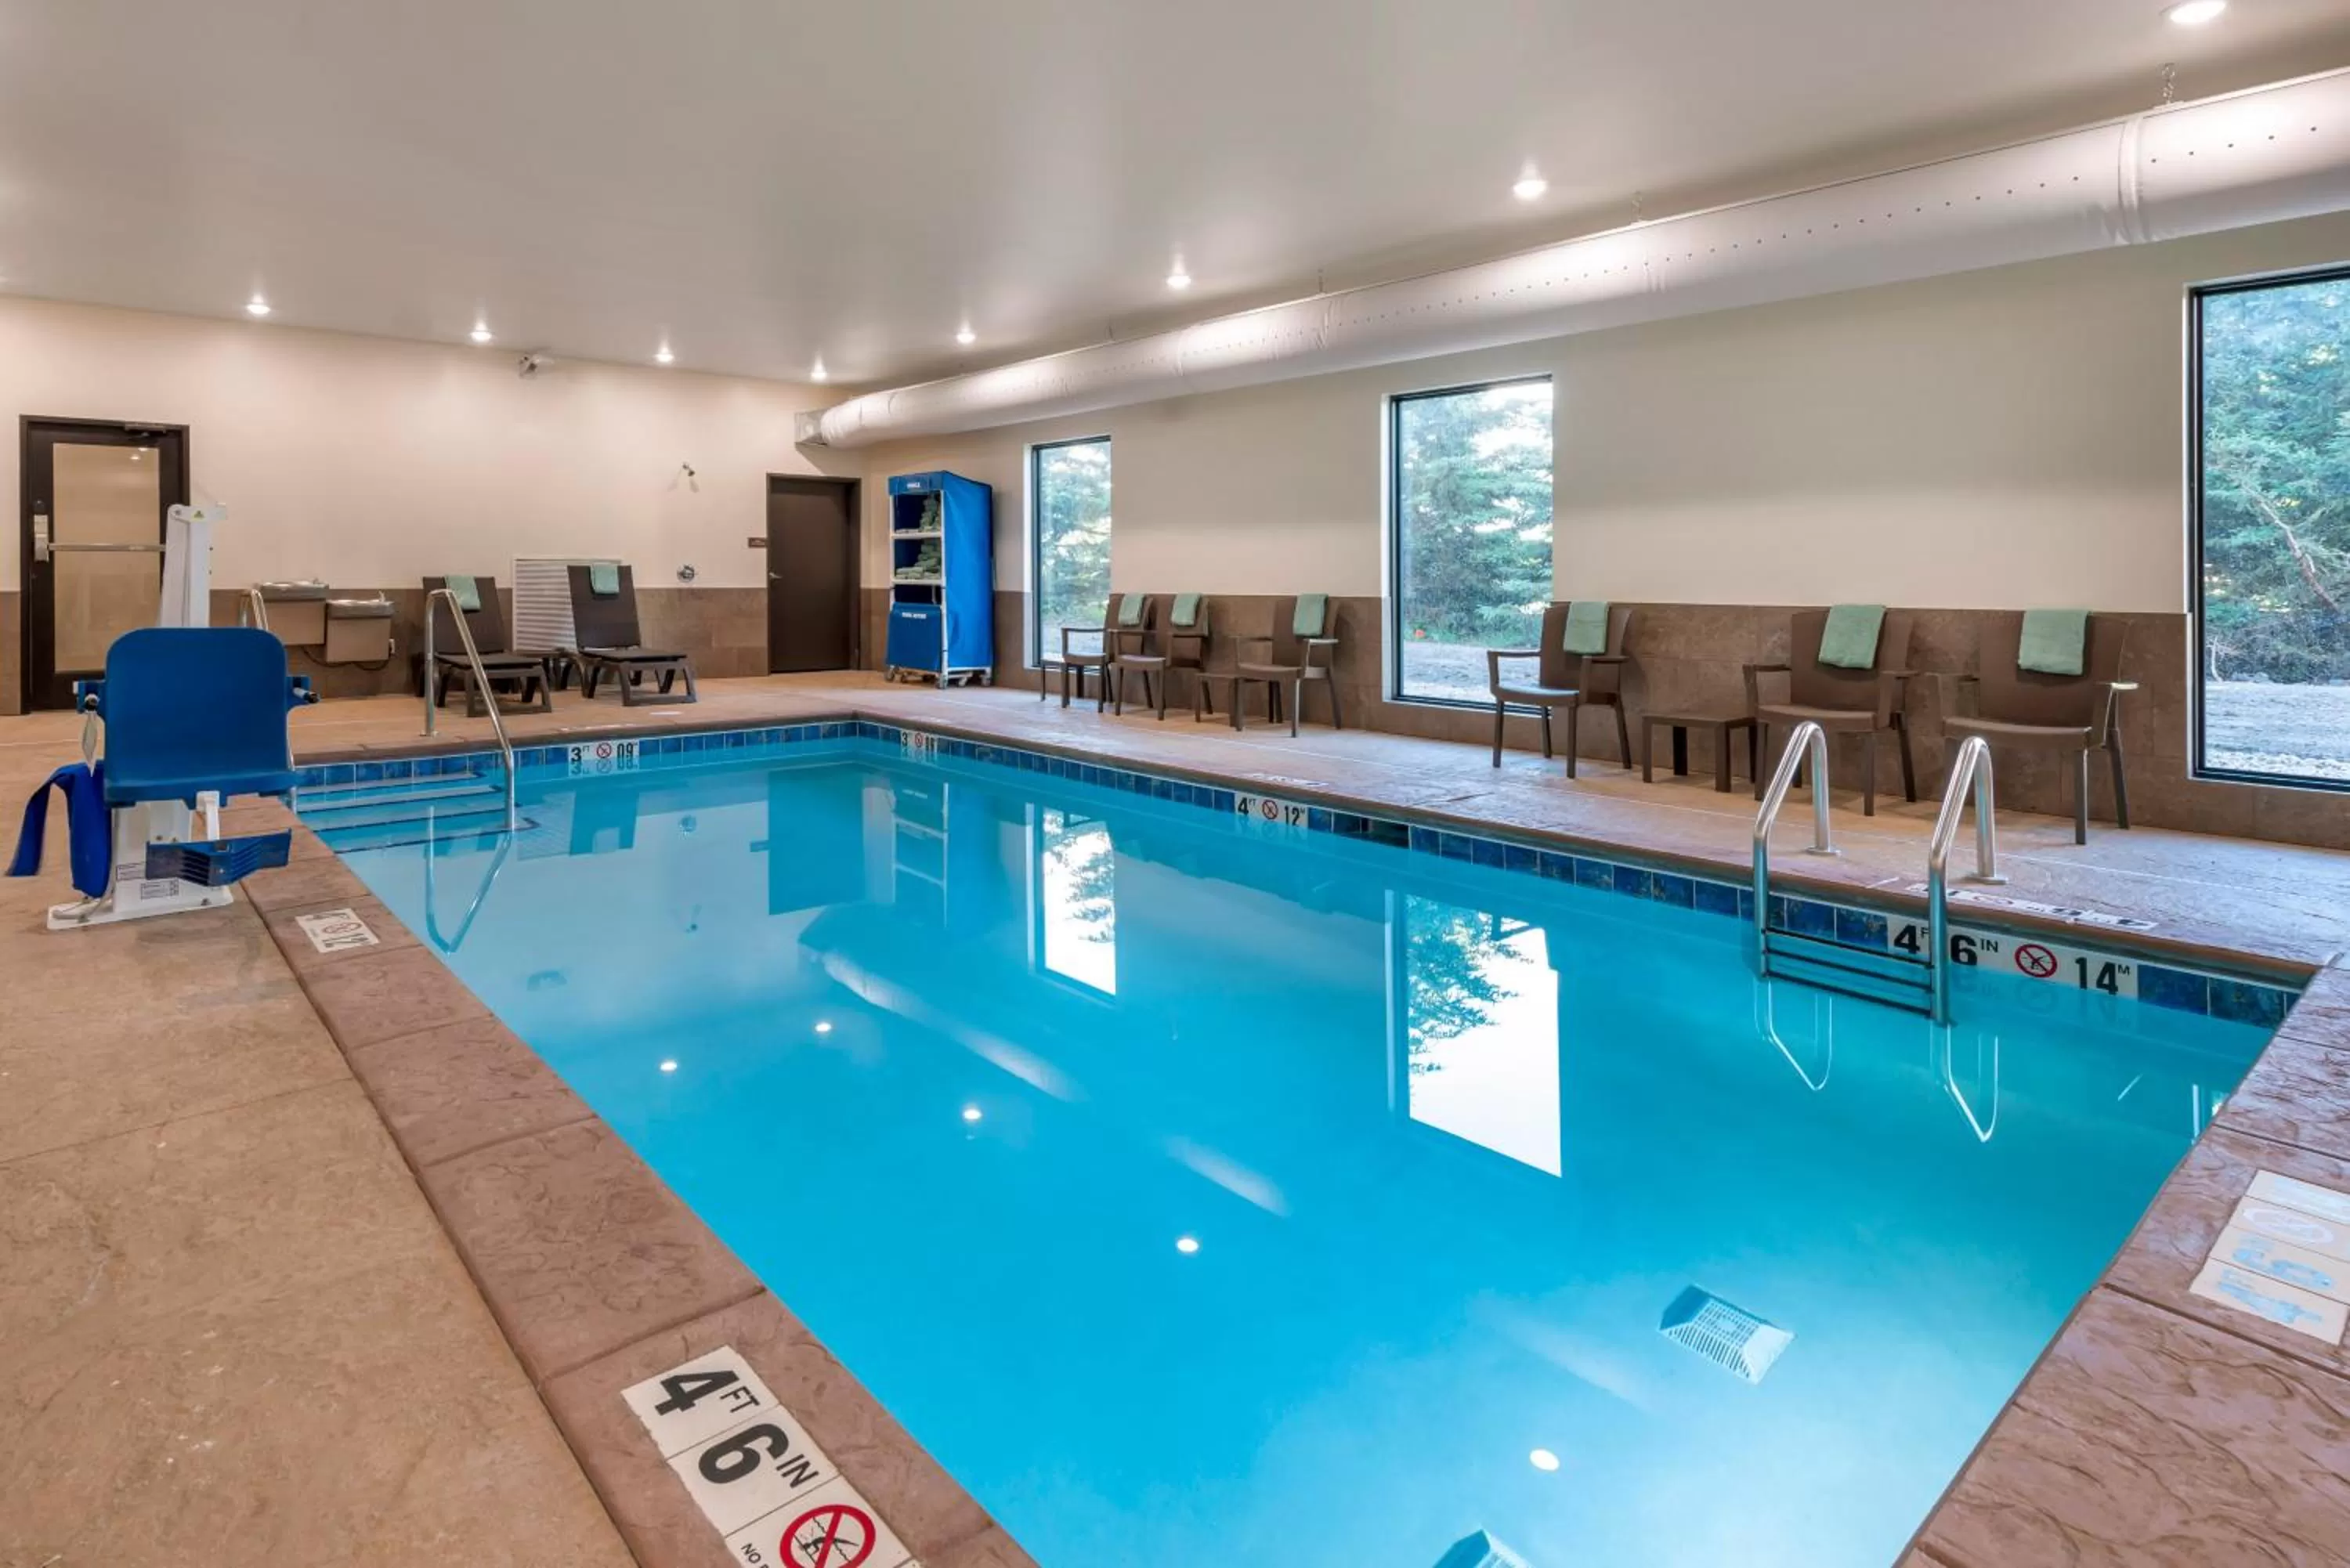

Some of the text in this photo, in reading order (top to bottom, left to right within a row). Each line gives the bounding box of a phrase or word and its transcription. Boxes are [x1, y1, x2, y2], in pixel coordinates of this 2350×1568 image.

[572, 746, 581, 761] 3
[1238, 797, 1249, 815] 4
[1285, 805, 1300, 826] 12
[1894, 924, 1920, 954] 4
[1950, 934, 1977, 966] 6
[1980, 938, 1998, 952] IN
[2075, 956, 2118, 995] 14
[2118, 964, 2130, 975] M
[655, 1371, 819, 1488] 4 FT 6 IN
[740, 1542, 761, 1564] NO
